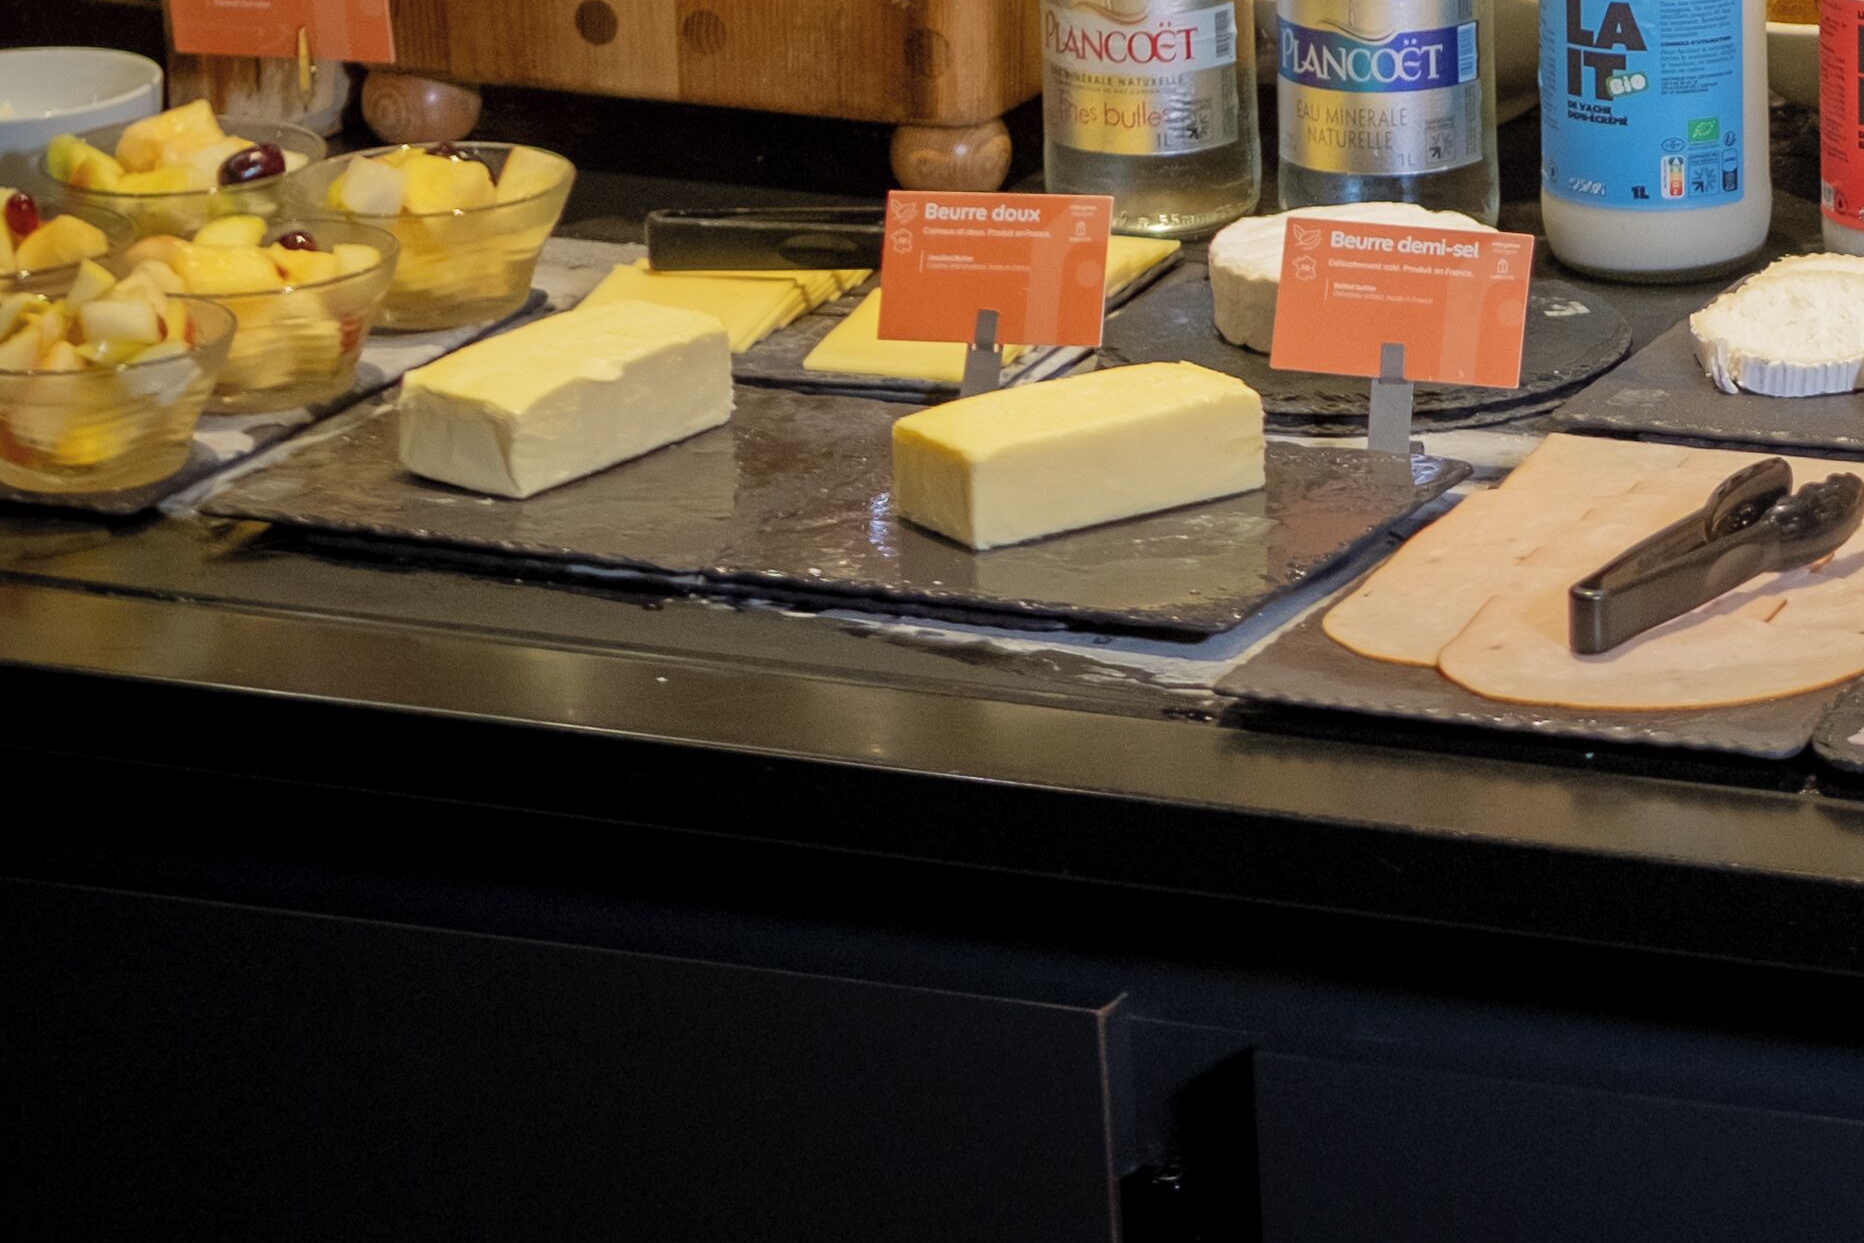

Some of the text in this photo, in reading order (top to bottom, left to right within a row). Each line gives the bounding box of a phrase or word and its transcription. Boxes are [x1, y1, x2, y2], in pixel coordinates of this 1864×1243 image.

[1043, 8, 1198, 63] PLANCOËT
[1281, 26, 1443, 83] PLANCOËT
[1297, 100, 1320, 121] EAU
[1578, 102, 1612, 114] VACHE
[1156, 133, 1174, 148] 1L
[1307, 126, 1393, 150] NATURELLE
[1400, 153, 1416, 167] 1L
[1631, 185, 1650, 200] 1L
[924, 203, 1041, 223] Beurre doux
[1330, 230, 1394, 253] Beurre
[1397, 236, 1479, 259] demi-sel
